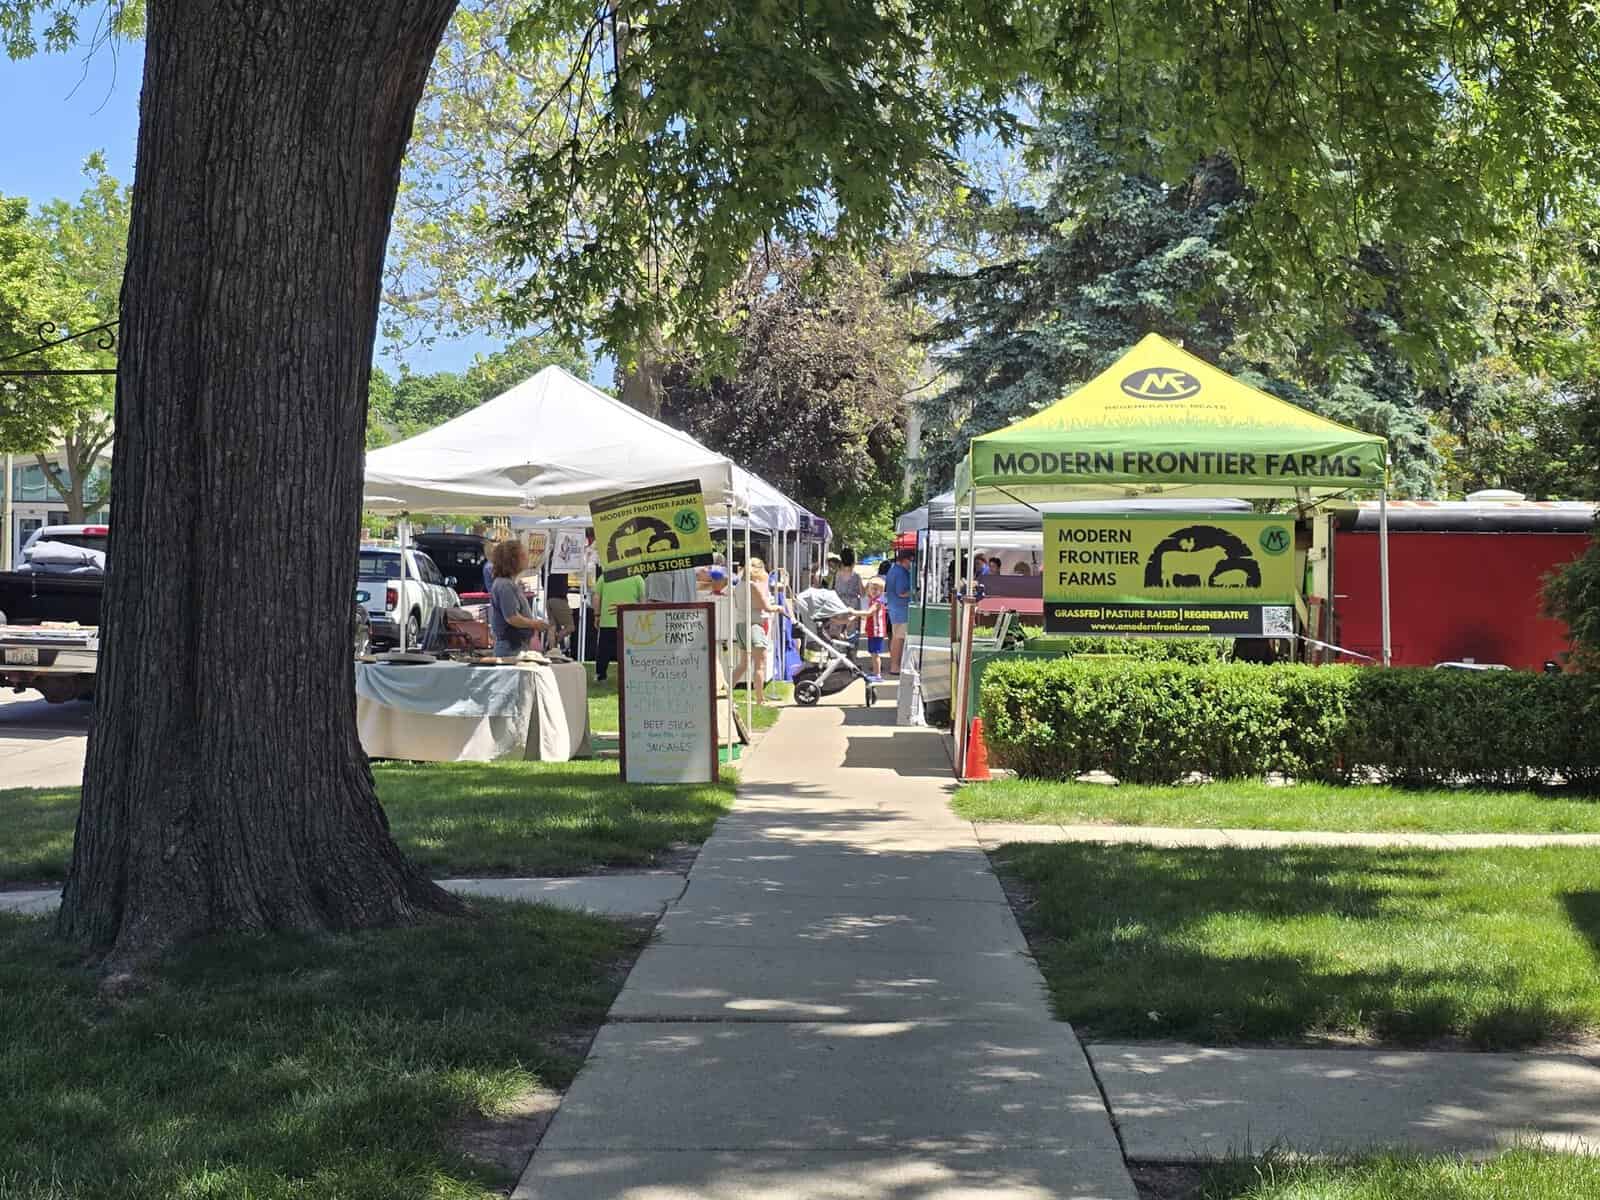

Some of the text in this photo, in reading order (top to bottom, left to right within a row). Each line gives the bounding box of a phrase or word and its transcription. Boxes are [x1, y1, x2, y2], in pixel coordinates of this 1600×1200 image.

[994, 451, 1361, 477] MODERN FRONTIER FARMS
[600, 497, 697, 521] MODERN FRONTIER FARMS
[1059, 528, 1132, 543] MODERN
[1059, 550, 1139, 565] FRONTIER
[627, 558, 692, 576] FARM STORE
[1059, 571, 1117, 586] FARMS
[665, 610, 700, 621] MODERN
[1055, 609, 1249, 620] GRASSFED PASTURE RAISED REGENERATIVE
[1090, 622, 1210, 632] www.amodernfrontier.com
[665, 632, 695, 644] FARMS
